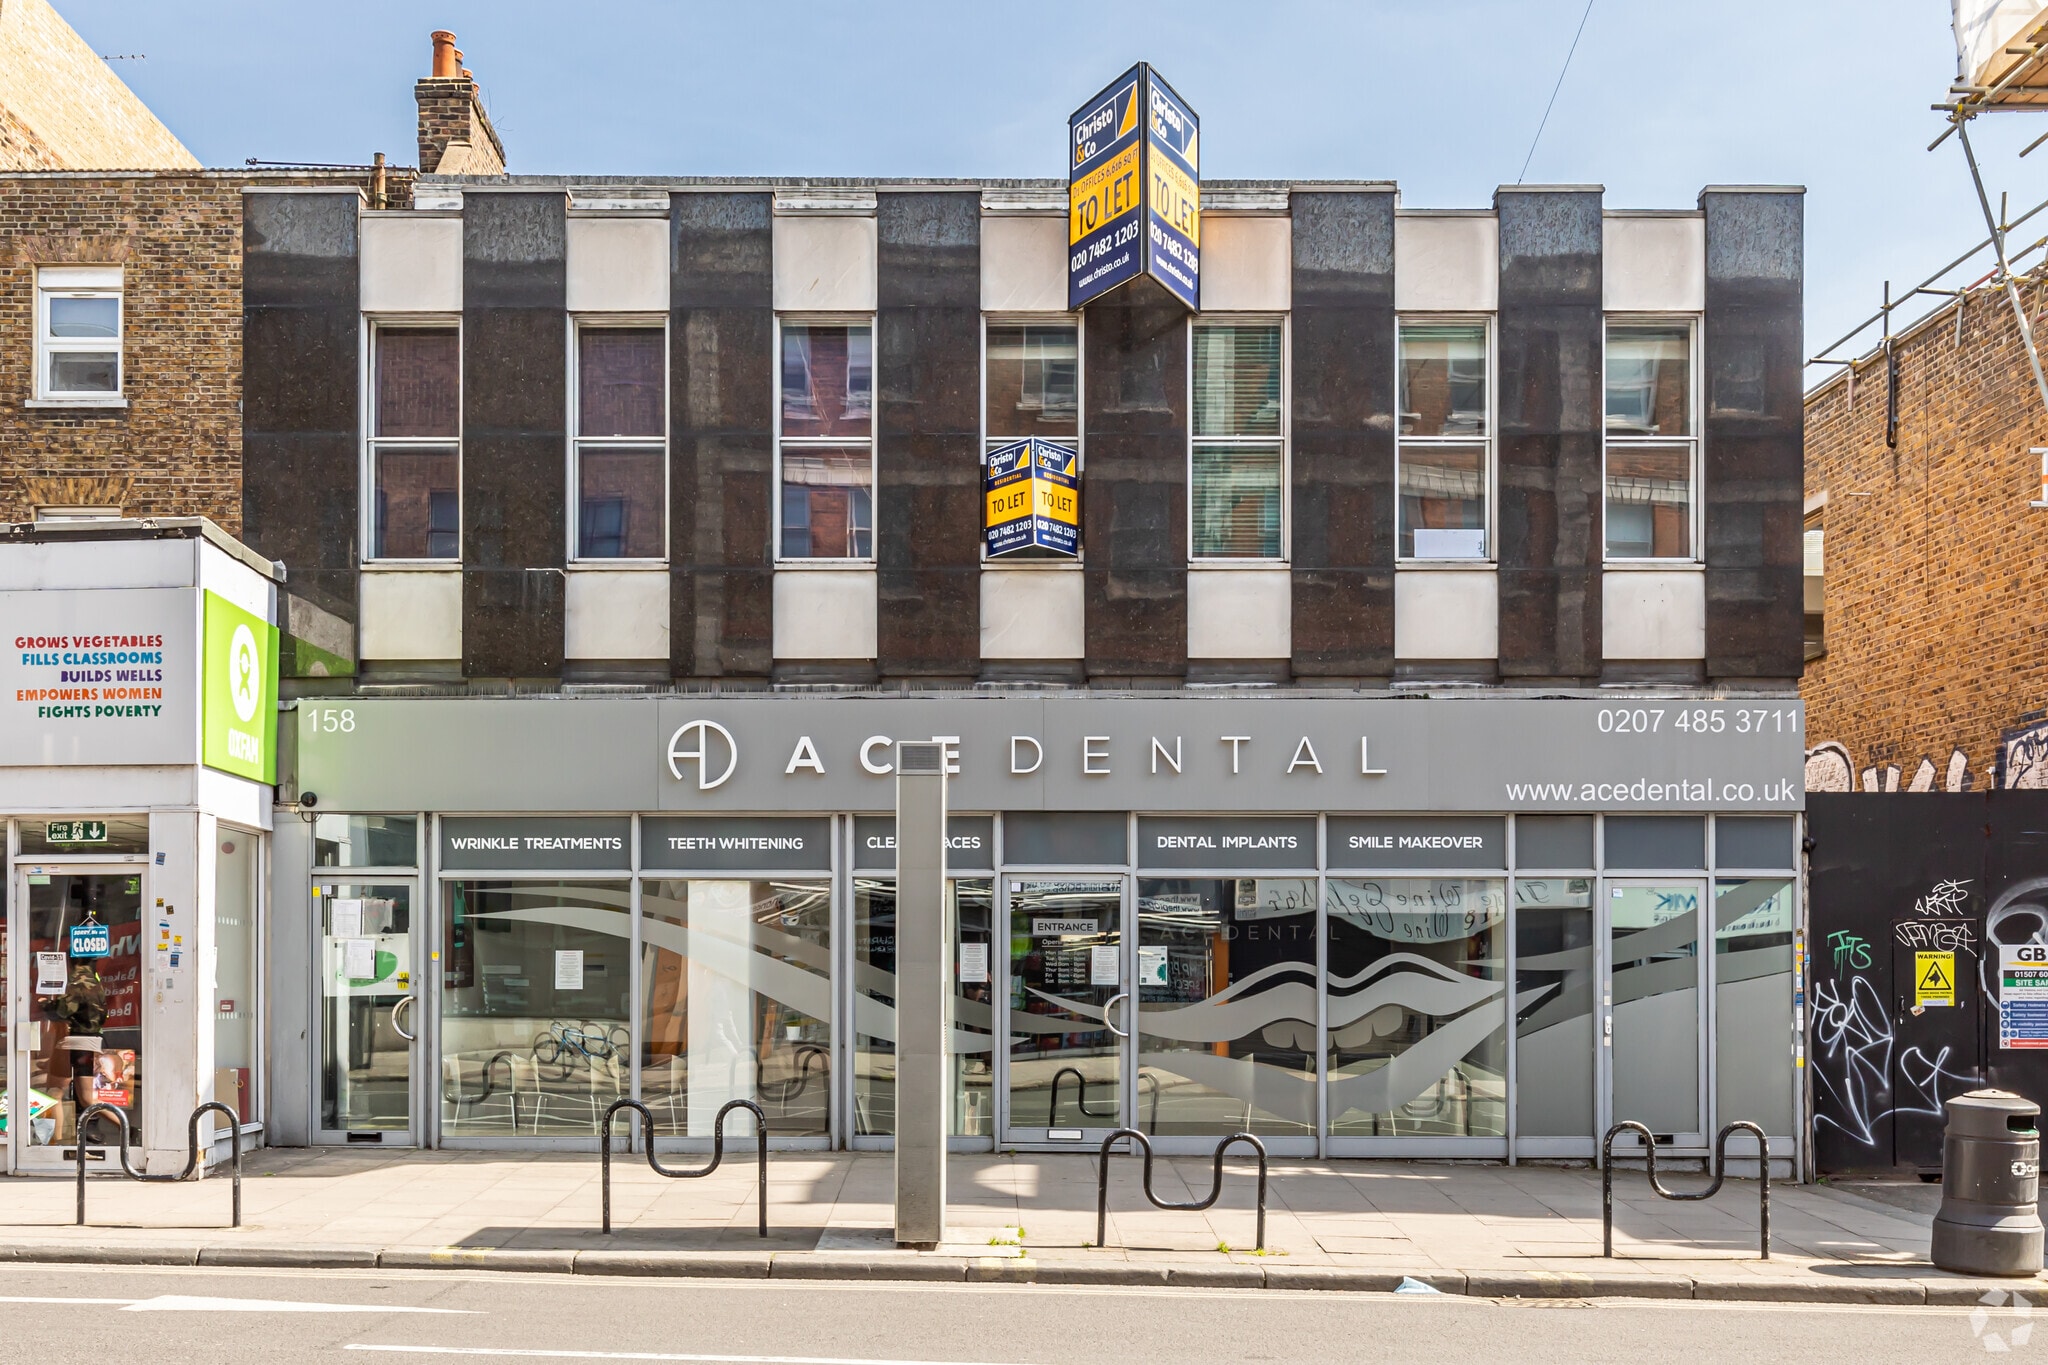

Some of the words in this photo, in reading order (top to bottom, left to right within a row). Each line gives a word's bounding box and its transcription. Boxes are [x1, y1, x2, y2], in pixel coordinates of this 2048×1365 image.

[1152, 89, 1181, 132] Christo
[1076, 107, 1113, 145] Christo
[1081, 168, 1105, 193] OFFICES
[1078, 194, 1098, 236] TO
[1104, 170, 1133, 219] LET
[1155, 173, 1169, 217] TO
[1174, 191, 1194, 238] LET
[1071, 249, 1087, 273] 020
[1089, 234, 1113, 262] 7482
[1115, 220, 1139, 247] 1203
[1151, 220, 1162, 246] 020
[1163, 232, 1183, 261] 7482
[1184, 248, 1198, 275] 1203
[1079, 251, 1130, 288] www.christo.co.uk
[990, 453, 1013, 466] Christo
[1038, 446, 1061, 462] Christo
[992, 498, 1005, 514] TO
[1008, 491, 1025, 509] LET
[1042, 491, 1055, 507] TO
[1057, 496, 1072, 513] LET
[988, 529, 999, 540] 020
[1000, 525, 1014, 537] 7482
[1015, 520, 1032, 533] 1203
[1037, 519, 1049, 531] 020
[1049, 523, 1063, 535] 7482
[1064, 527, 1076, 539] 1203
[15, 636, 69, 649] GROWS
[72, 635, 163, 648] VEGETABLES
[22, 652, 59, 665] FILLS
[63, 652, 162, 665] CLASSROOMS
[60, 669, 112, 682] BUILDS
[116, 669, 162, 682] WELLS
[16, 688, 98, 701] EMPOWERS
[102, 687, 162, 700] WOMEN
[38, 706, 91, 718] FIGHTS
[95, 705, 162, 717] POVERTY
[307, 709, 356, 733] 158
[1597, 709, 1665, 733] 0207
[1674, 709, 1726, 733] 485
[1735, 709, 1797, 733] 3711
[228, 728, 259, 764] OXFAM
[785, 735, 960, 775] ACE
[1010, 735, 1388, 774] DENTAL
[1505, 777, 1796, 802] www.acedental.co.uk
[51, 823, 68, 832] Fire
[51, 831, 68, 840] exit
[451, 837, 519, 850] WRINKLE
[524, 837, 622, 850] TREATMENTS
[667, 837, 716, 850] TEETH
[719, 837, 804, 850] WHITENING
[866, 836, 898, 849] CLE
[944, 836, 981, 849] ACES
[1157, 836, 1217, 849] DENTAL
[1222, 836, 1298, 849] IMPLANTS
[1348, 836, 1394, 849] SMILE
[1398, 836, 1483, 849] MAKEOVER
[1037, 922, 1093, 931] ENTRANCE
[73, 938, 107, 952] CLOSED
[2014, 970, 2037, 978] 01507
[2015, 979, 2033, 987] SITE
